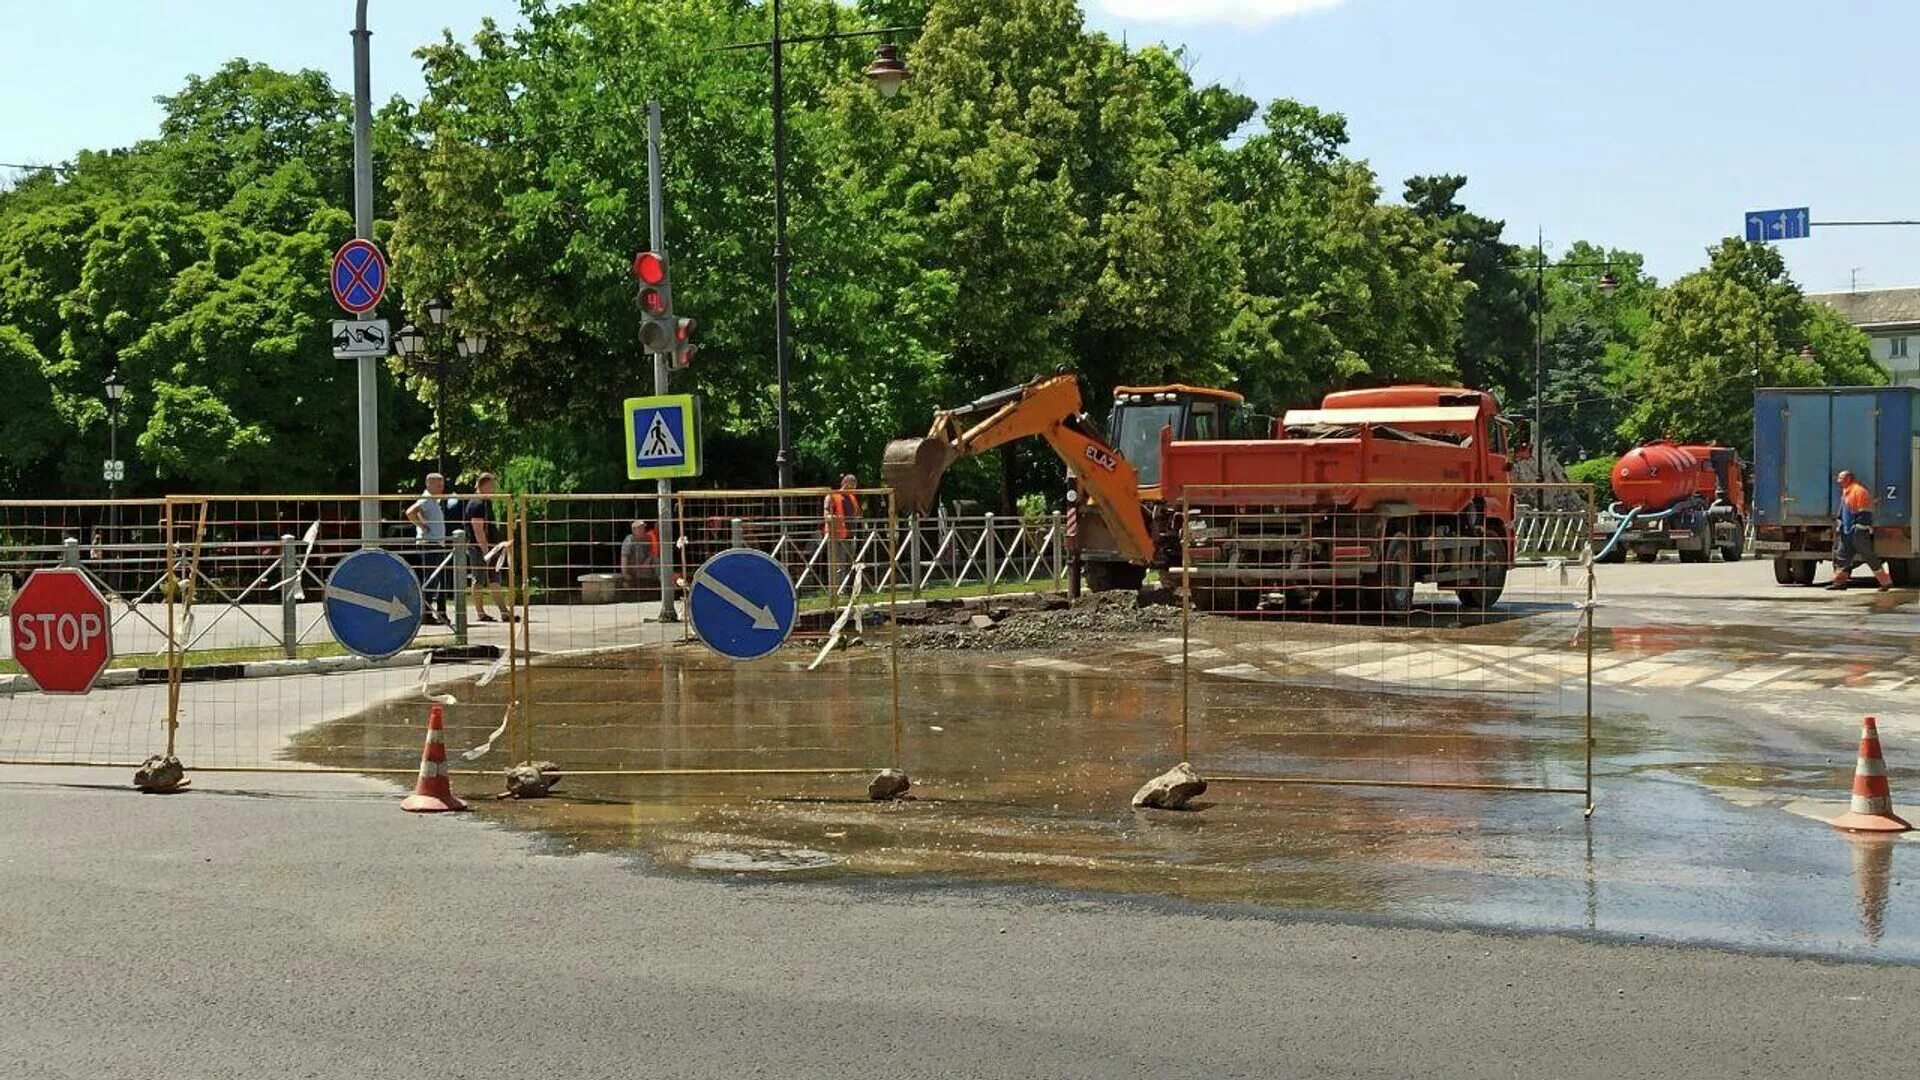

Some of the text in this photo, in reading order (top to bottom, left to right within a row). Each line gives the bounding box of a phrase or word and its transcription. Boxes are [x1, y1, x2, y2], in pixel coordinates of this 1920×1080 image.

[1086, 445, 1117, 471] ELAZ
[1886, 486, 1896, 499] Z
[18, 613, 102, 651] STOP
